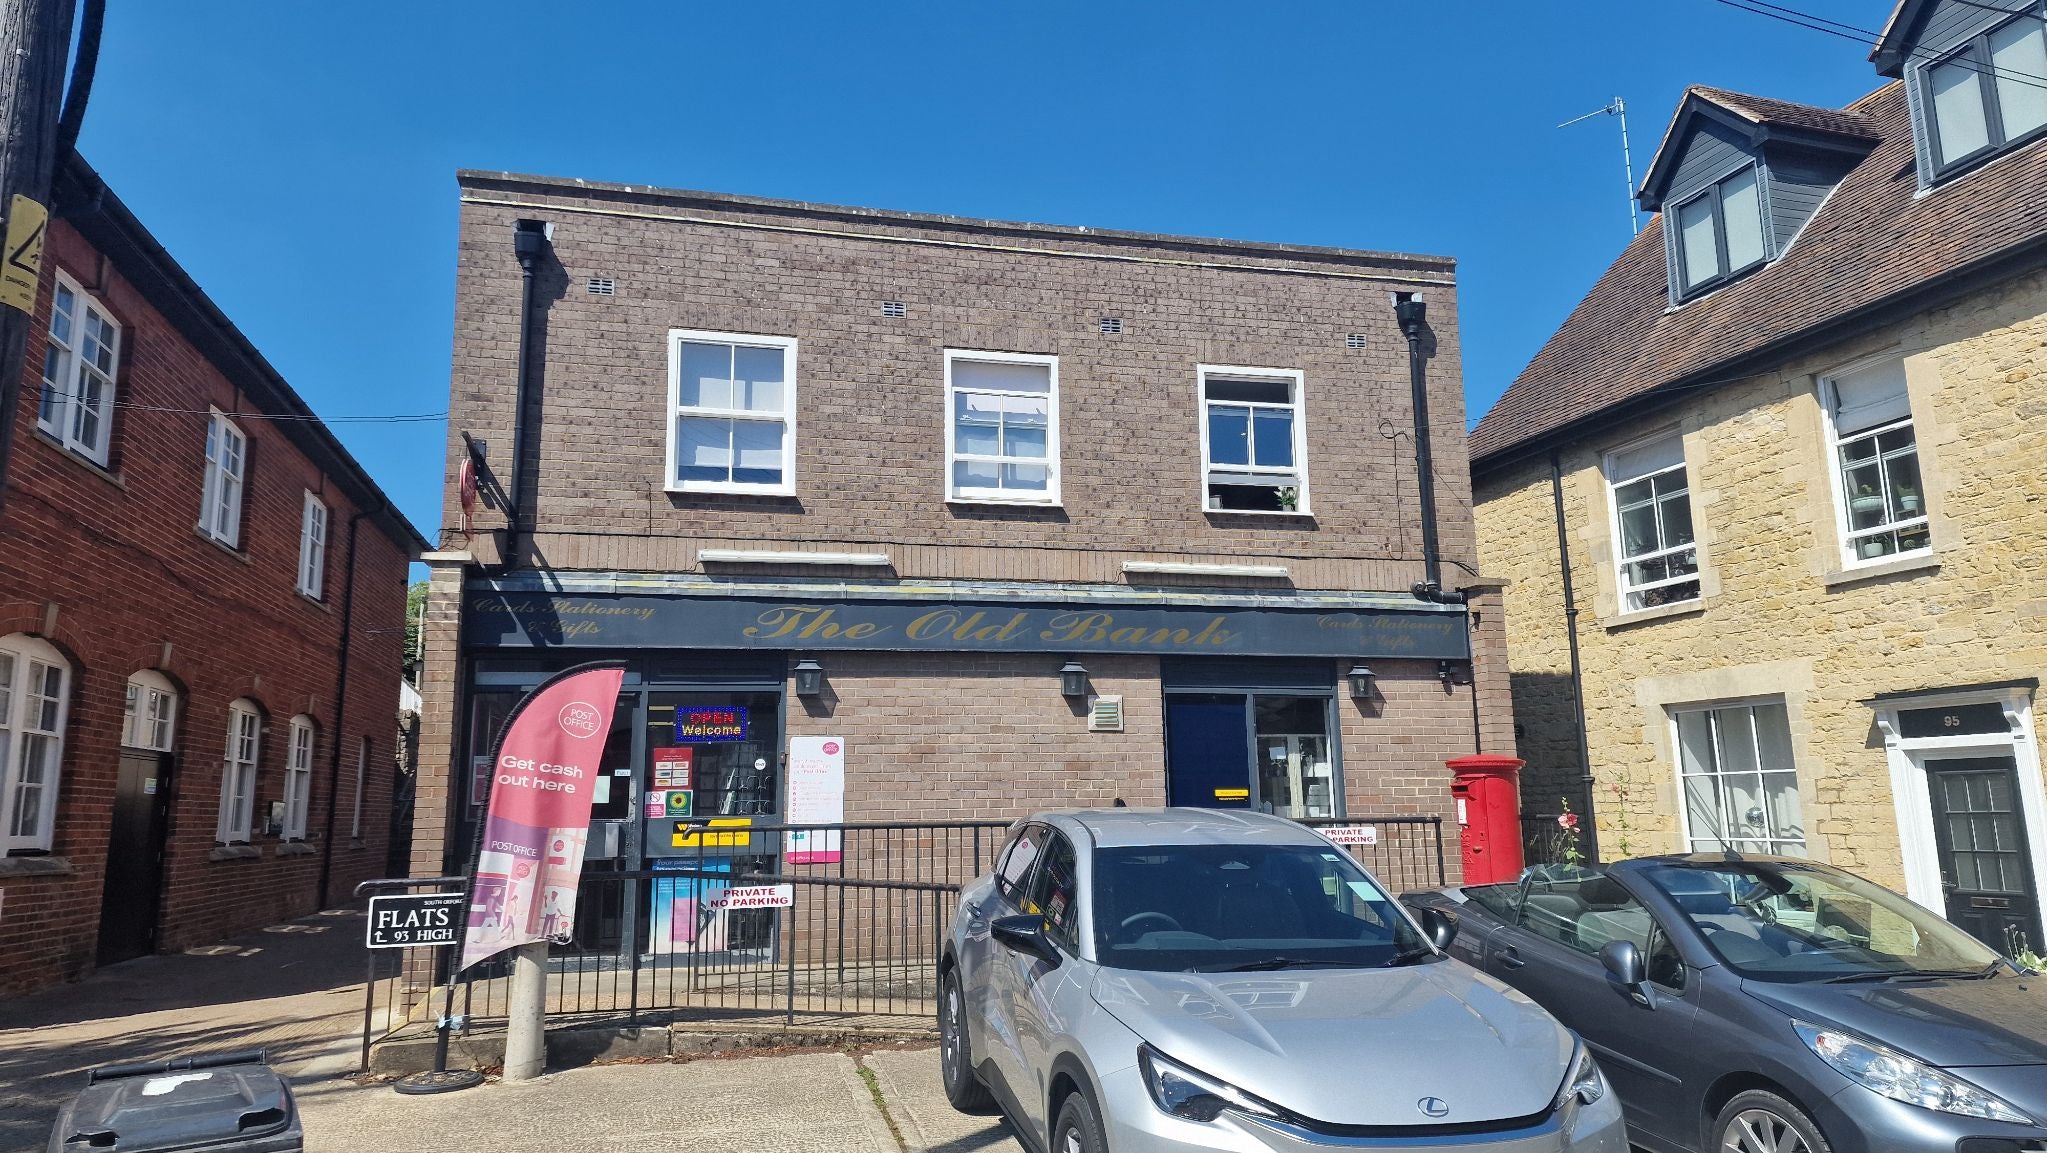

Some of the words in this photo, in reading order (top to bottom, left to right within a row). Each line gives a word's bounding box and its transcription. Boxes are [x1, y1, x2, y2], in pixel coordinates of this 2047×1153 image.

[474, 599, 536, 613] Cards
[542, 599, 657, 620] Stationery
[553, 619, 603, 638] Gifts
[743, 606, 893, 640] The
[906, 609, 1031, 641] Old
[1040, 611, 1243, 645] Bank
[571, 708, 593, 719] POST
[690, 711, 735, 725] OPEN
[563, 716, 595, 731] OFFICE
[1944, 716, 1960, 727] 95
[682, 724, 742, 736] Welcome
[501, 755, 536, 771] Get
[539, 763, 583, 779] cash
[498, 774, 529, 787] out
[532, 776, 576, 794] here
[491, 840, 513, 851] POST
[513, 844, 537, 857] OFFICE
[723, 887, 776, 898] PRIVATE
[710, 900, 729, 908] NO
[732, 896, 789, 907] PARKING
[376, 907, 450, 929] FLATS
[394, 930, 410, 942] 93
[417, 929, 453, 941] HIGH
